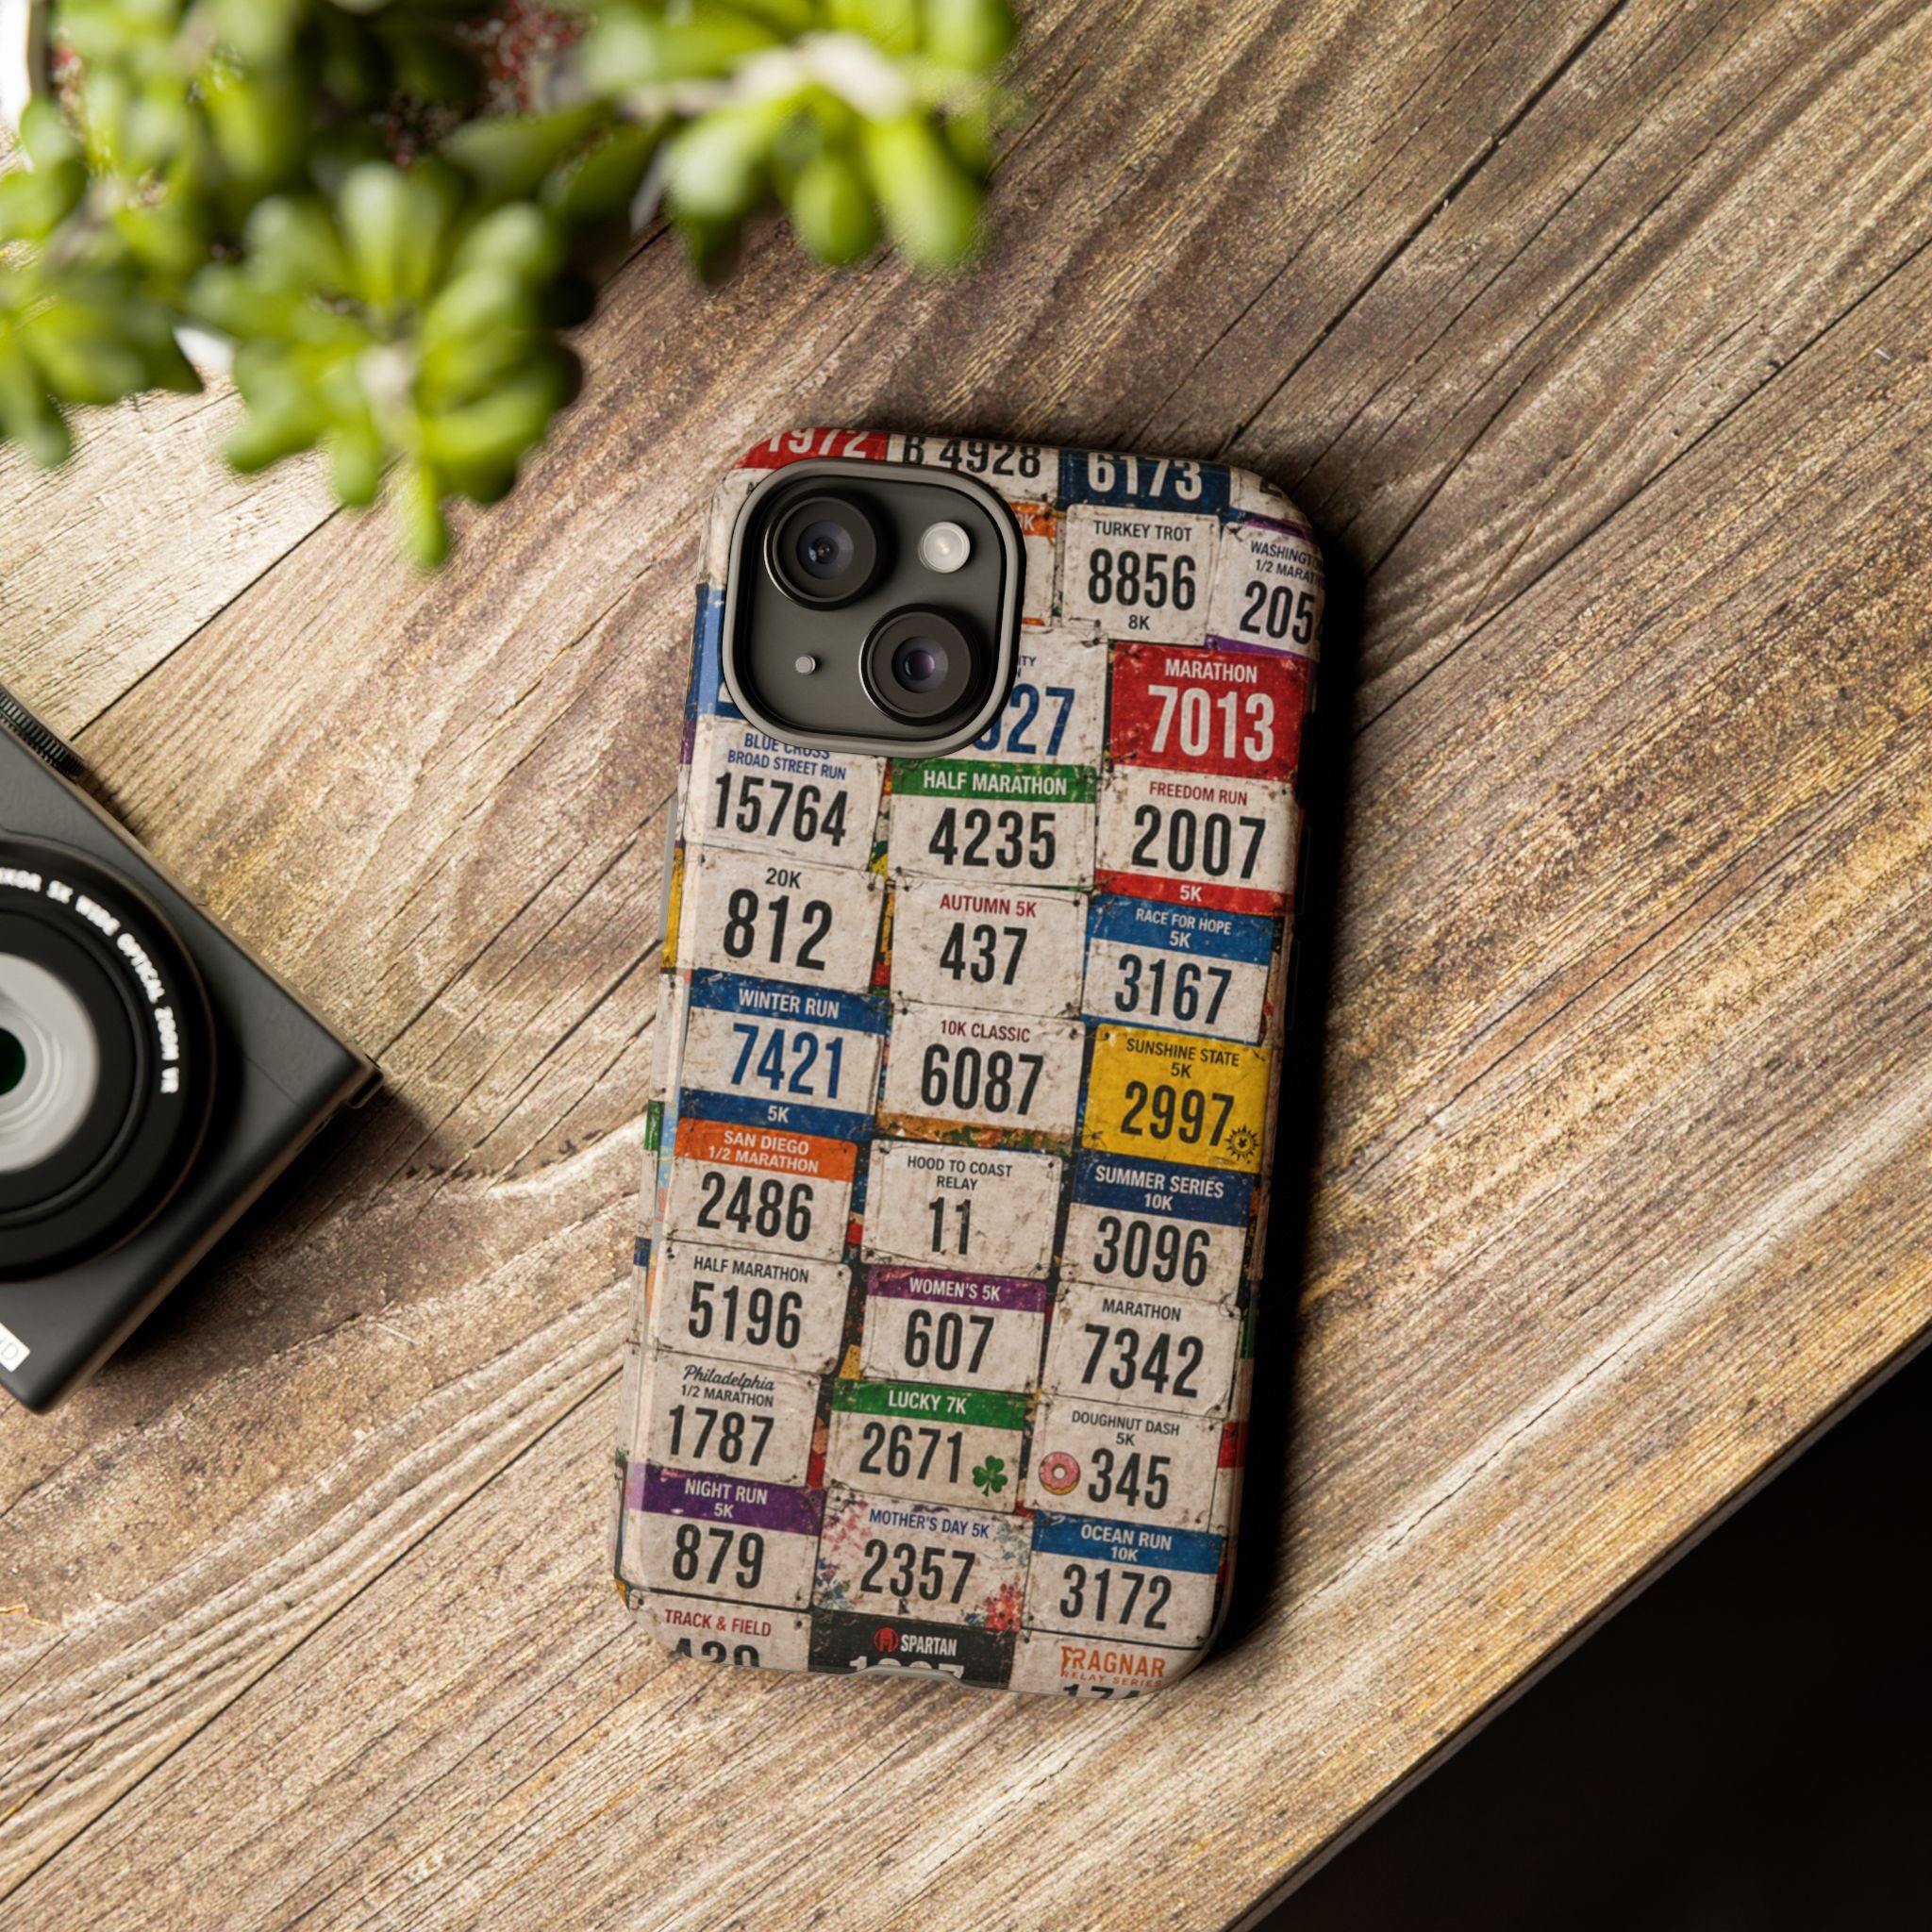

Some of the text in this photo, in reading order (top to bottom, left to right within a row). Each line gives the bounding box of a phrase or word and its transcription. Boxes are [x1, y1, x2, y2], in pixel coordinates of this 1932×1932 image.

[903, 434, 1041, 478] B 4928
[1088, 452, 1203, 501] 6173
[1093, 520, 1192, 542] TURKEY TROT
[1088, 548, 1196, 611] 8856
[1256, 558, 1274, 574] 1/2
[1127, 615, 1150, 631] 8K
[1165, 658, 1257, 684] MARATHON
[1147, 684, 1274, 762] 7013
[743, 732, 779, 752] BLUE
[727, 749, 847, 781] BROAD STREET RUN
[924, 769, 1067, 796] HALF MARATHON
[1149, 780, 1248, 807] FREEDOM RUN
[715, 772, 848, 847] 15764
[928, 807, 1057, 870] 4235
[1131, 804, 1266, 880] 2007
[765, 867, 803, 890] 20K
[940, 892, 1037, 918] AUTUMN 5K
[1179, 884, 1203, 903] 5K
[723, 889, 833, 972] 812
[1136, 908, 1232, 935] RACE FOR HOPE
[1169, 930, 1191, 948] 5K
[939, 922, 1027, 986] 437
[117, 932, 165, 1004] OPTICAL
[154, 1006, 179, 1060] ZOOM
[738, 988, 840, 1019] WINTER RUN
[1114, 953, 1232, 1025] 3167
[941, 1019, 1031, 1042] 10K CLASSIC
[730, 1022, 843, 1099] 7421
[1126, 1038, 1240, 1068] SUNSHINE STATE
[921, 1042, 1044, 1116] 6087
[1170, 1061, 1191, 1078] 5K
[767, 1105, 791, 1123] 5K
[1120, 1080, 1235, 1146] 2997
[724, 1129, 809, 1156] SAN DIEGO
[708, 1145, 819, 1174] 1/2 MARATHON
[907, 1155, 1013, 1178] HOOD TO COAST
[936, 1174, 978, 1191] RELAY
[1095, 1164, 1224, 1199] SUMMER SERIES
[697, 1171, 814, 1242] 2486
[1143, 1192, 1174, 1211] 10K
[928, 1196, 971, 1256] 11
[1092, 1215, 1210, 1288] 3096
[693, 1255, 809, 1284] HALF MARATHON
[908, 1277, 1001, 1302] WOMEN'S 5K
[688, 1280, 803, 1349] 5196
[1102, 1298, 1181, 1322] MARATHON
[904, 1308, 995, 1374] 607
[1081, 1322, 1204, 1398] 7342
[682, 1363, 775, 1394] Philadelphia
[680, 1384, 774, 1408] 1/2 MARATHON
[888, 1389, 967, 1415] LUCKY 7K
[669, 1404, 774, 1467] 1787
[1072, 1409, 1180, 1437] DOUGHNUT DASH
[858, 1421, 963, 1484] 2671
[1115, 1431, 1136, 1447] 5K
[684, 1478, 768, 1506] NIGHT RUN
[1088, 1447, 1172, 1509] 345
[713, 1503, 734, 1519] 5K
[869, 1508, 990, 1539] MOTHER'S DAY 5K
[1081, 1524, 1173, 1551] OCEAN RUN
[672, 1523, 765, 1590] 879
[1110, 1546, 1139, 1563] 10K
[859, 1539, 976, 1604] 2357
[1059, 1562, 1173, 1630] 3172
[664, 1608, 772, 1637] TRACK & FIELD
[901, 1634, 958, 1657] SPARTAN
[1060, 1646, 1166, 1677] RAGNAR
[1060, 1671, 1162, 1688] RELAY SERIES
